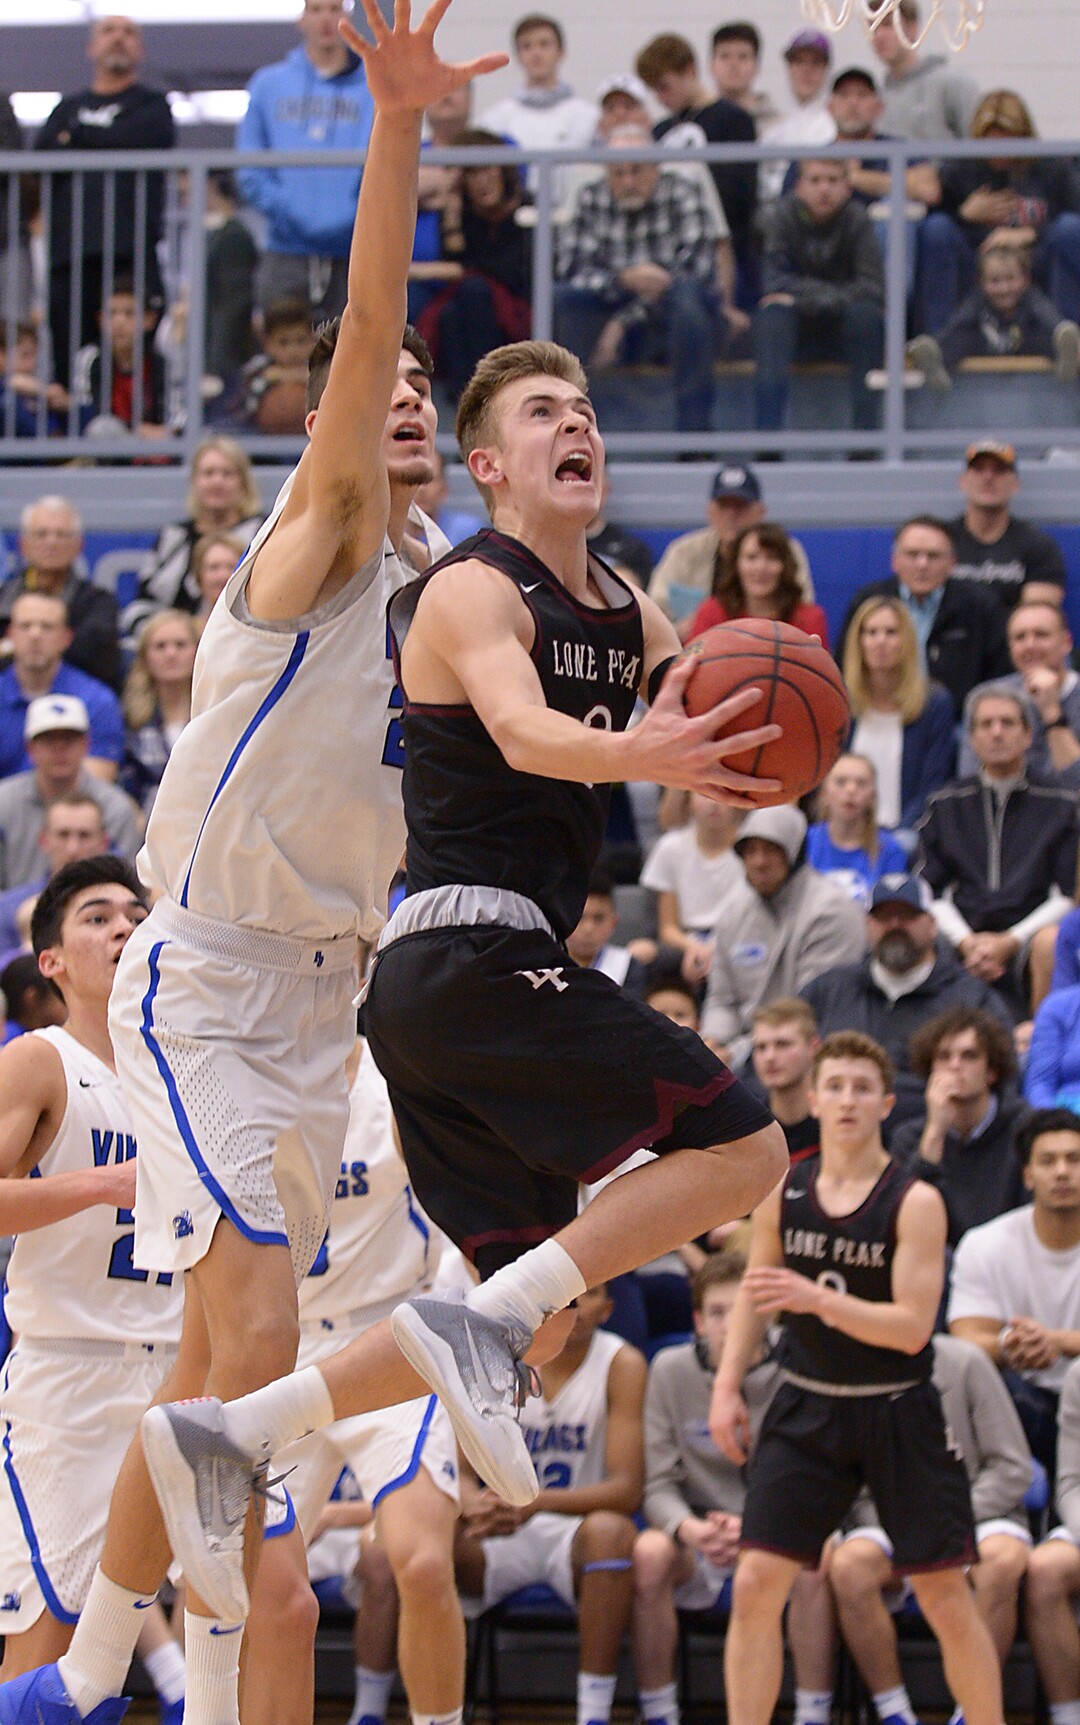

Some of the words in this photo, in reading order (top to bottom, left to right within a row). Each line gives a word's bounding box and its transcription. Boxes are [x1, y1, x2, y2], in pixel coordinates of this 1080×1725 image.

[552, 639, 598, 682] LONE
[608, 648, 640, 691] PA
[784, 1227, 828, 1259] LONE
[832, 1236, 886, 1268] PEAK
